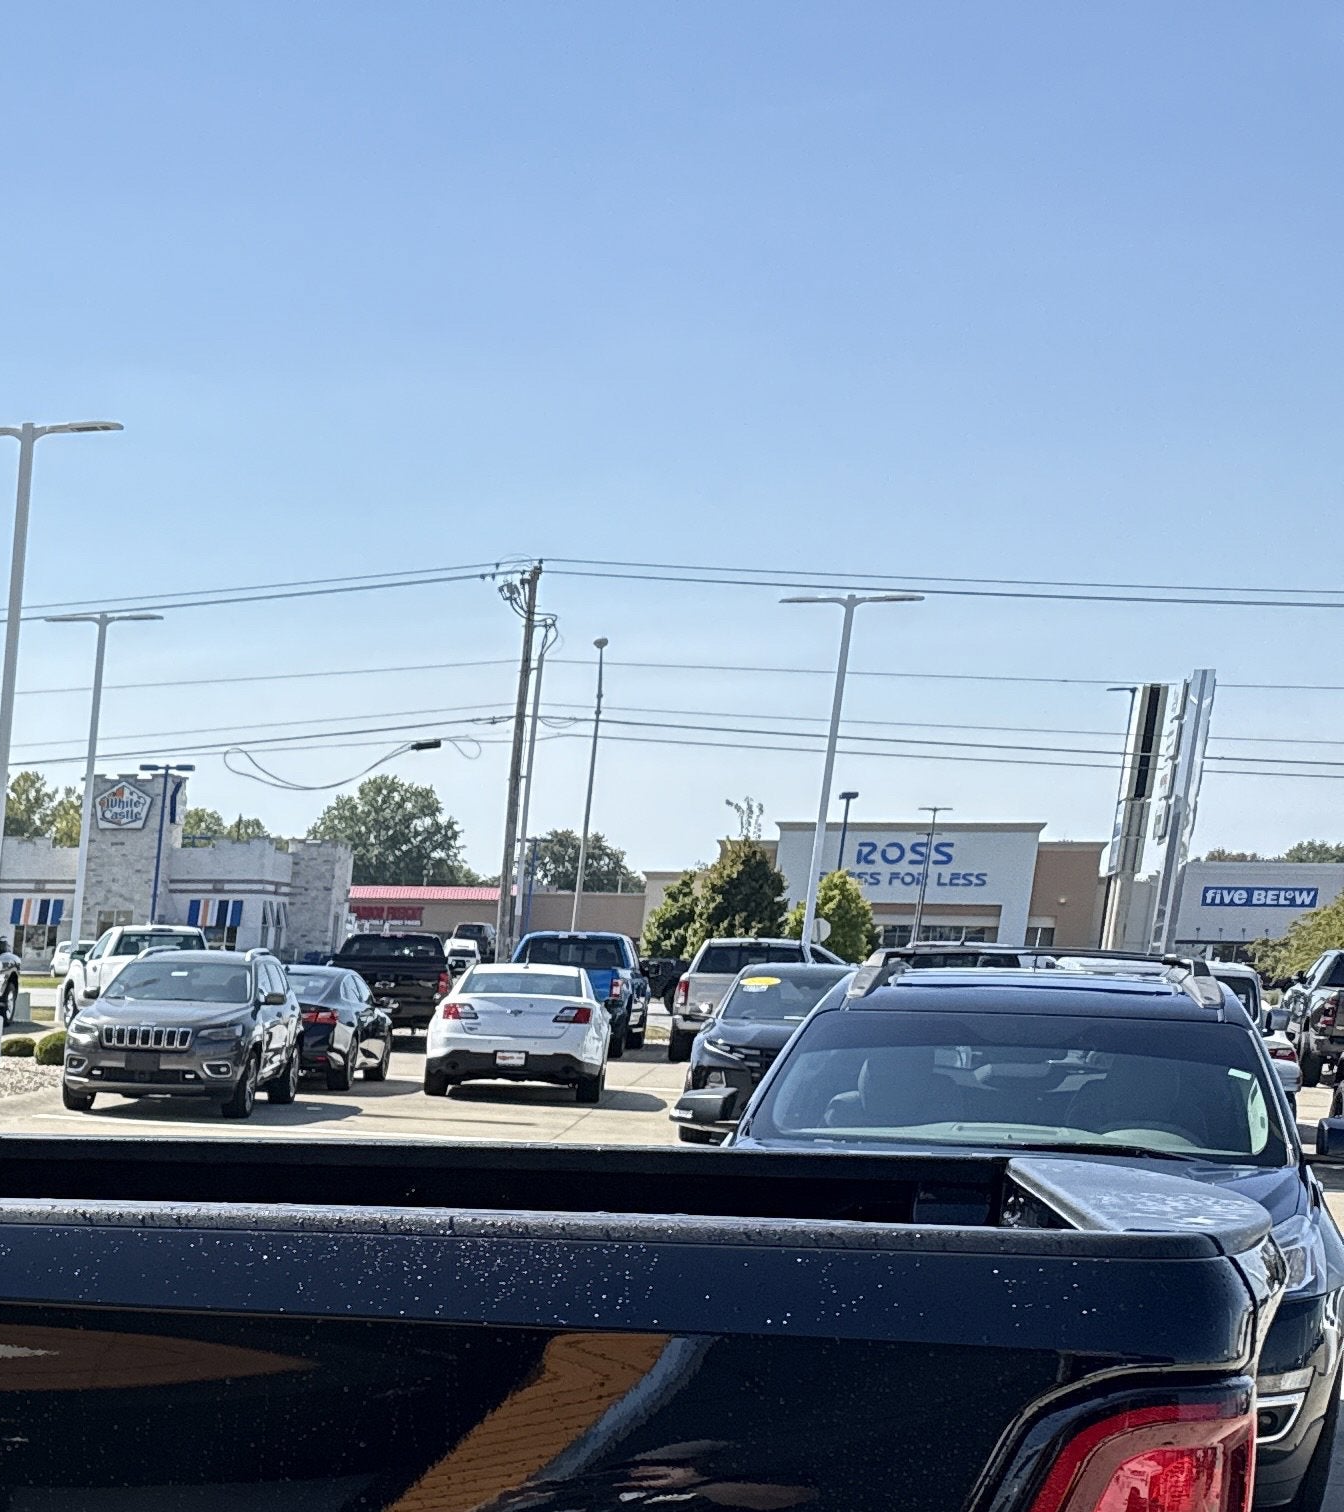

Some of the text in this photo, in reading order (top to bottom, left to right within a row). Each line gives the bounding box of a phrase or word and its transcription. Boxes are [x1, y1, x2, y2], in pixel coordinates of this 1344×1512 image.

[107, 798, 142, 810] White
[101, 809, 143, 821] Castle
[856, 841, 955, 865] ROSS
[936, 872, 988, 886] LESS
[1205, 888, 1315, 905] five BELOW
